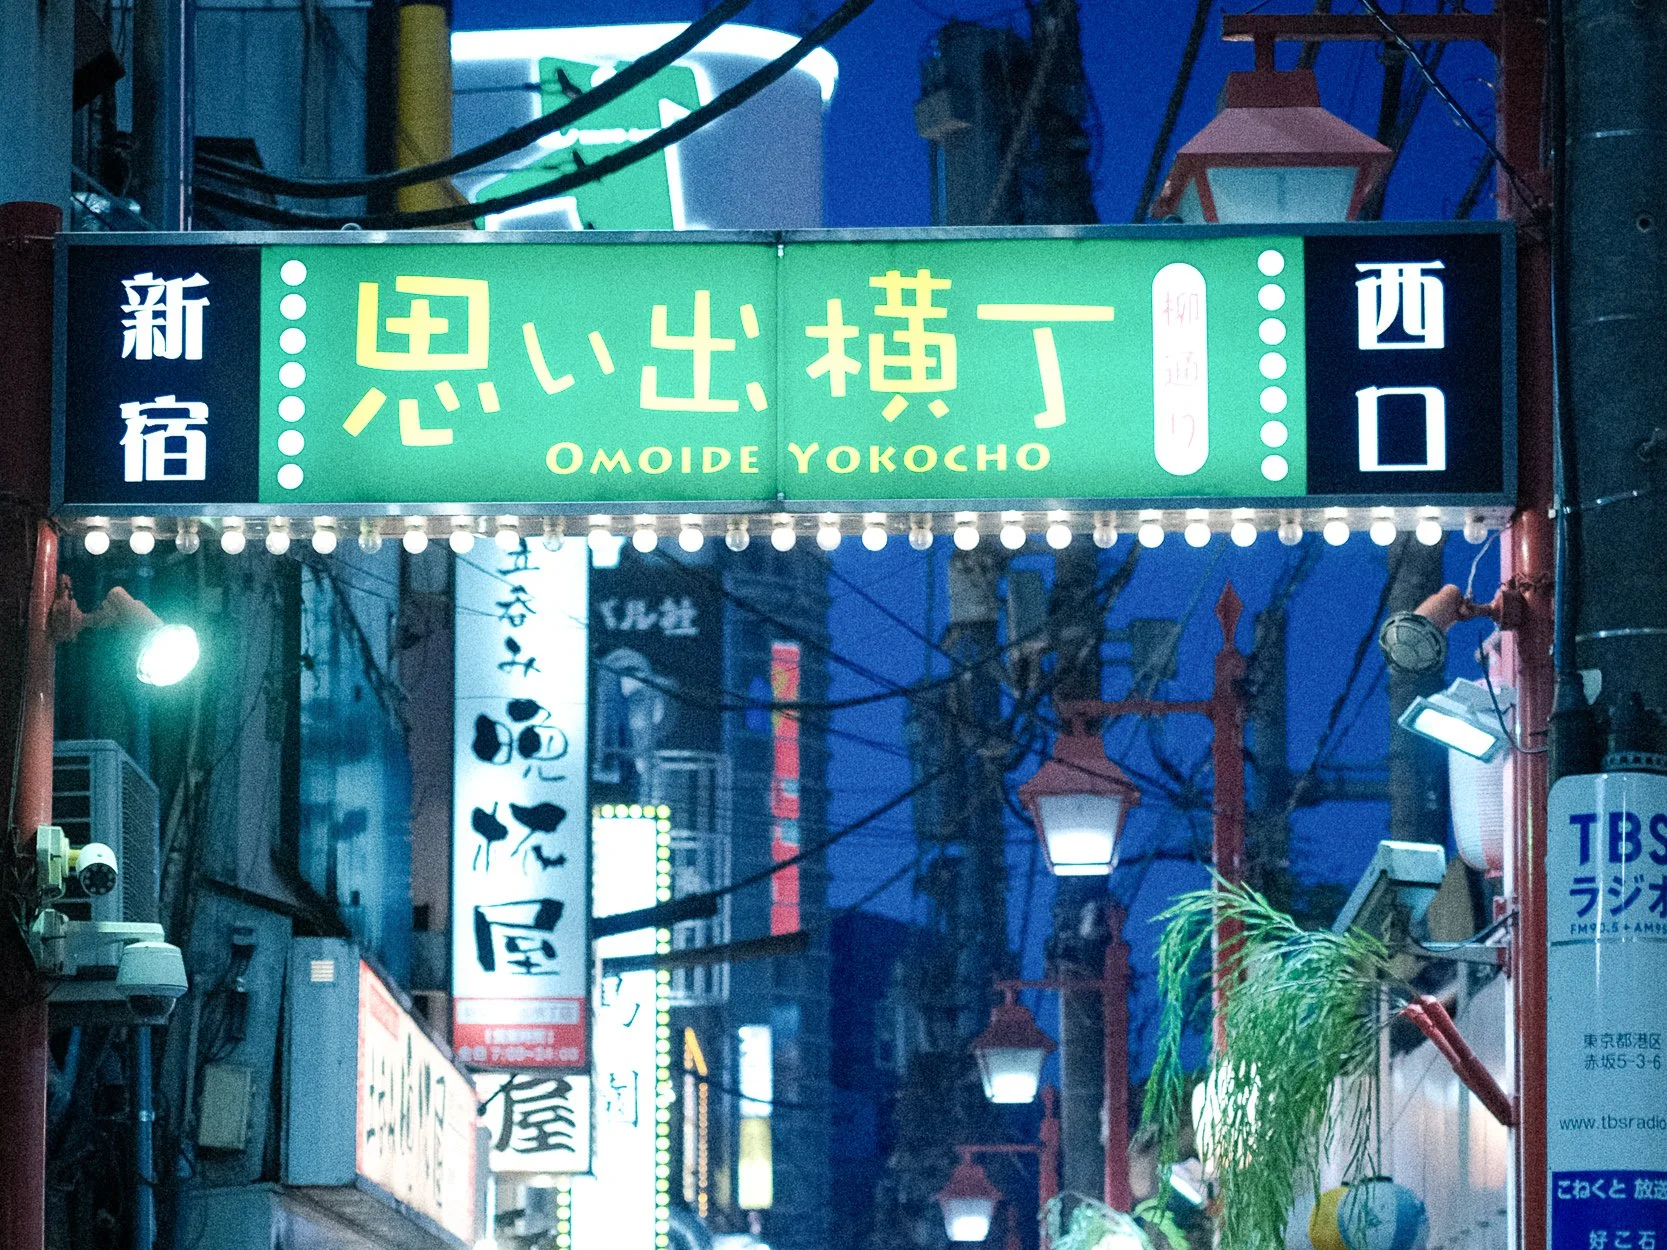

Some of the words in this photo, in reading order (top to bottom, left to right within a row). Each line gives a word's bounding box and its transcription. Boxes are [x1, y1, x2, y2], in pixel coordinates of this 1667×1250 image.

[120, 272, 209, 482] 新宿
[342, 268, 1115, 446] 思い出横丁
[1355, 260, 1446, 472] 西口
[545, 442, 760, 476] OMOIDE
[787, 441, 1051, 474] YOKOCHO
[1569, 812, 1667, 867] TBS
[1584, 1033, 1661, 1049] 東京都港区
[1584, 1054, 1661, 1070] 赤坂5-3-6
[494, 1076, 576, 1154] 屋
[1558, 1179, 1626, 1199] こねくと
